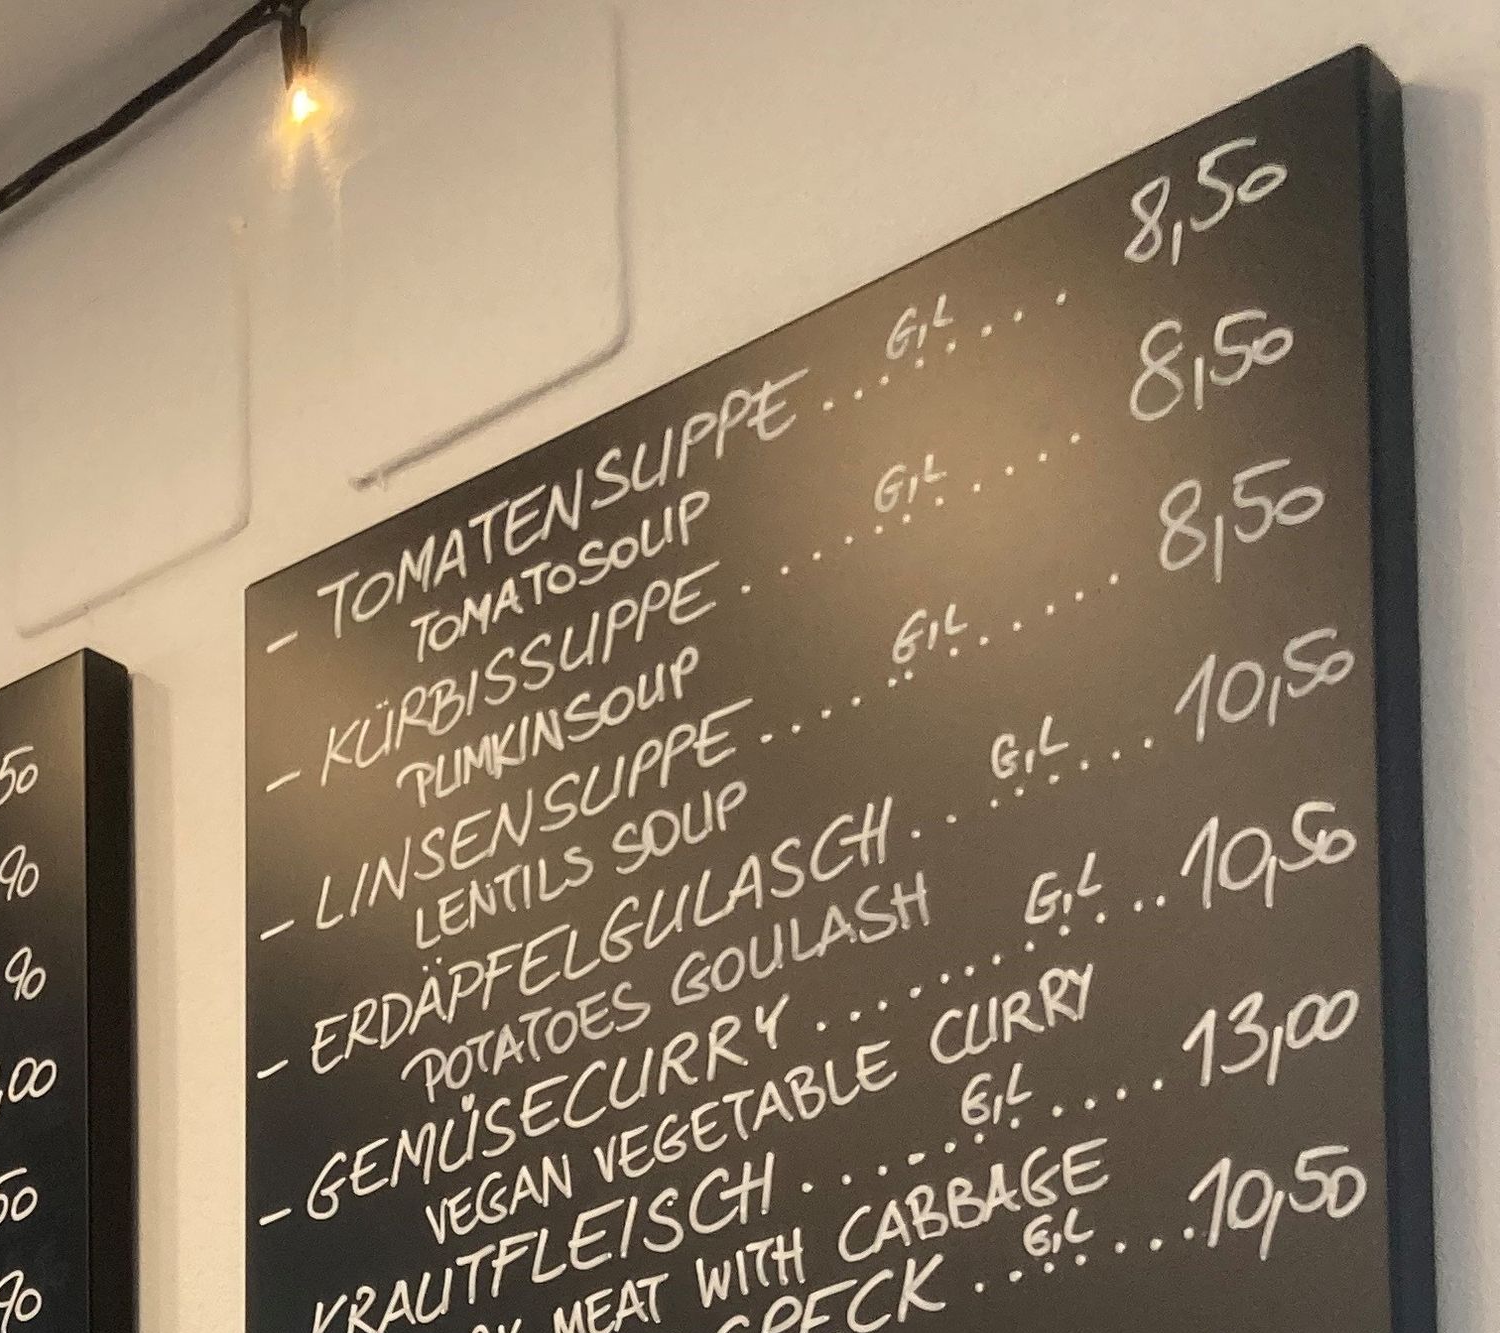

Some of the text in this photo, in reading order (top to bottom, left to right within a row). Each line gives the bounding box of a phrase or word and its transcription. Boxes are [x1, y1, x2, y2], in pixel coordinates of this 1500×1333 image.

[318, 369, 809, 638] TOMATENSUPPE
[1124, 138, 1286, 265] 8,50
[320, 561, 720, 786] KÜRBISSUPPE
[1130, 309, 1293, 421] 8,50
[316, 698, 753, 929] LINSENSUPPE
[1159, 458, 1324, 582] 8,50
[311, 796, 893, 1074] ERDÄPFELGULASCH
[1175, 628, 1355, 741] 10,50
[401, 872, 928, 1102] POTATOES GOULASH
[416, 781, 747, 948] LENTILS SOUP
[307, 993, 789, 1220] GEMÜSECURRY
[1181, 801, 1356, 909] 10,50
[426, 964, 1093, 1243] VEGAN VEGETABLE CURRY
[1183, 990, 1359, 1087] 13,00
[696, 1227, 806, 1307] WITH
[837, 1138, 1109, 1262] CABBAGE
[1189, 1145, 1367, 1261] 10,50
